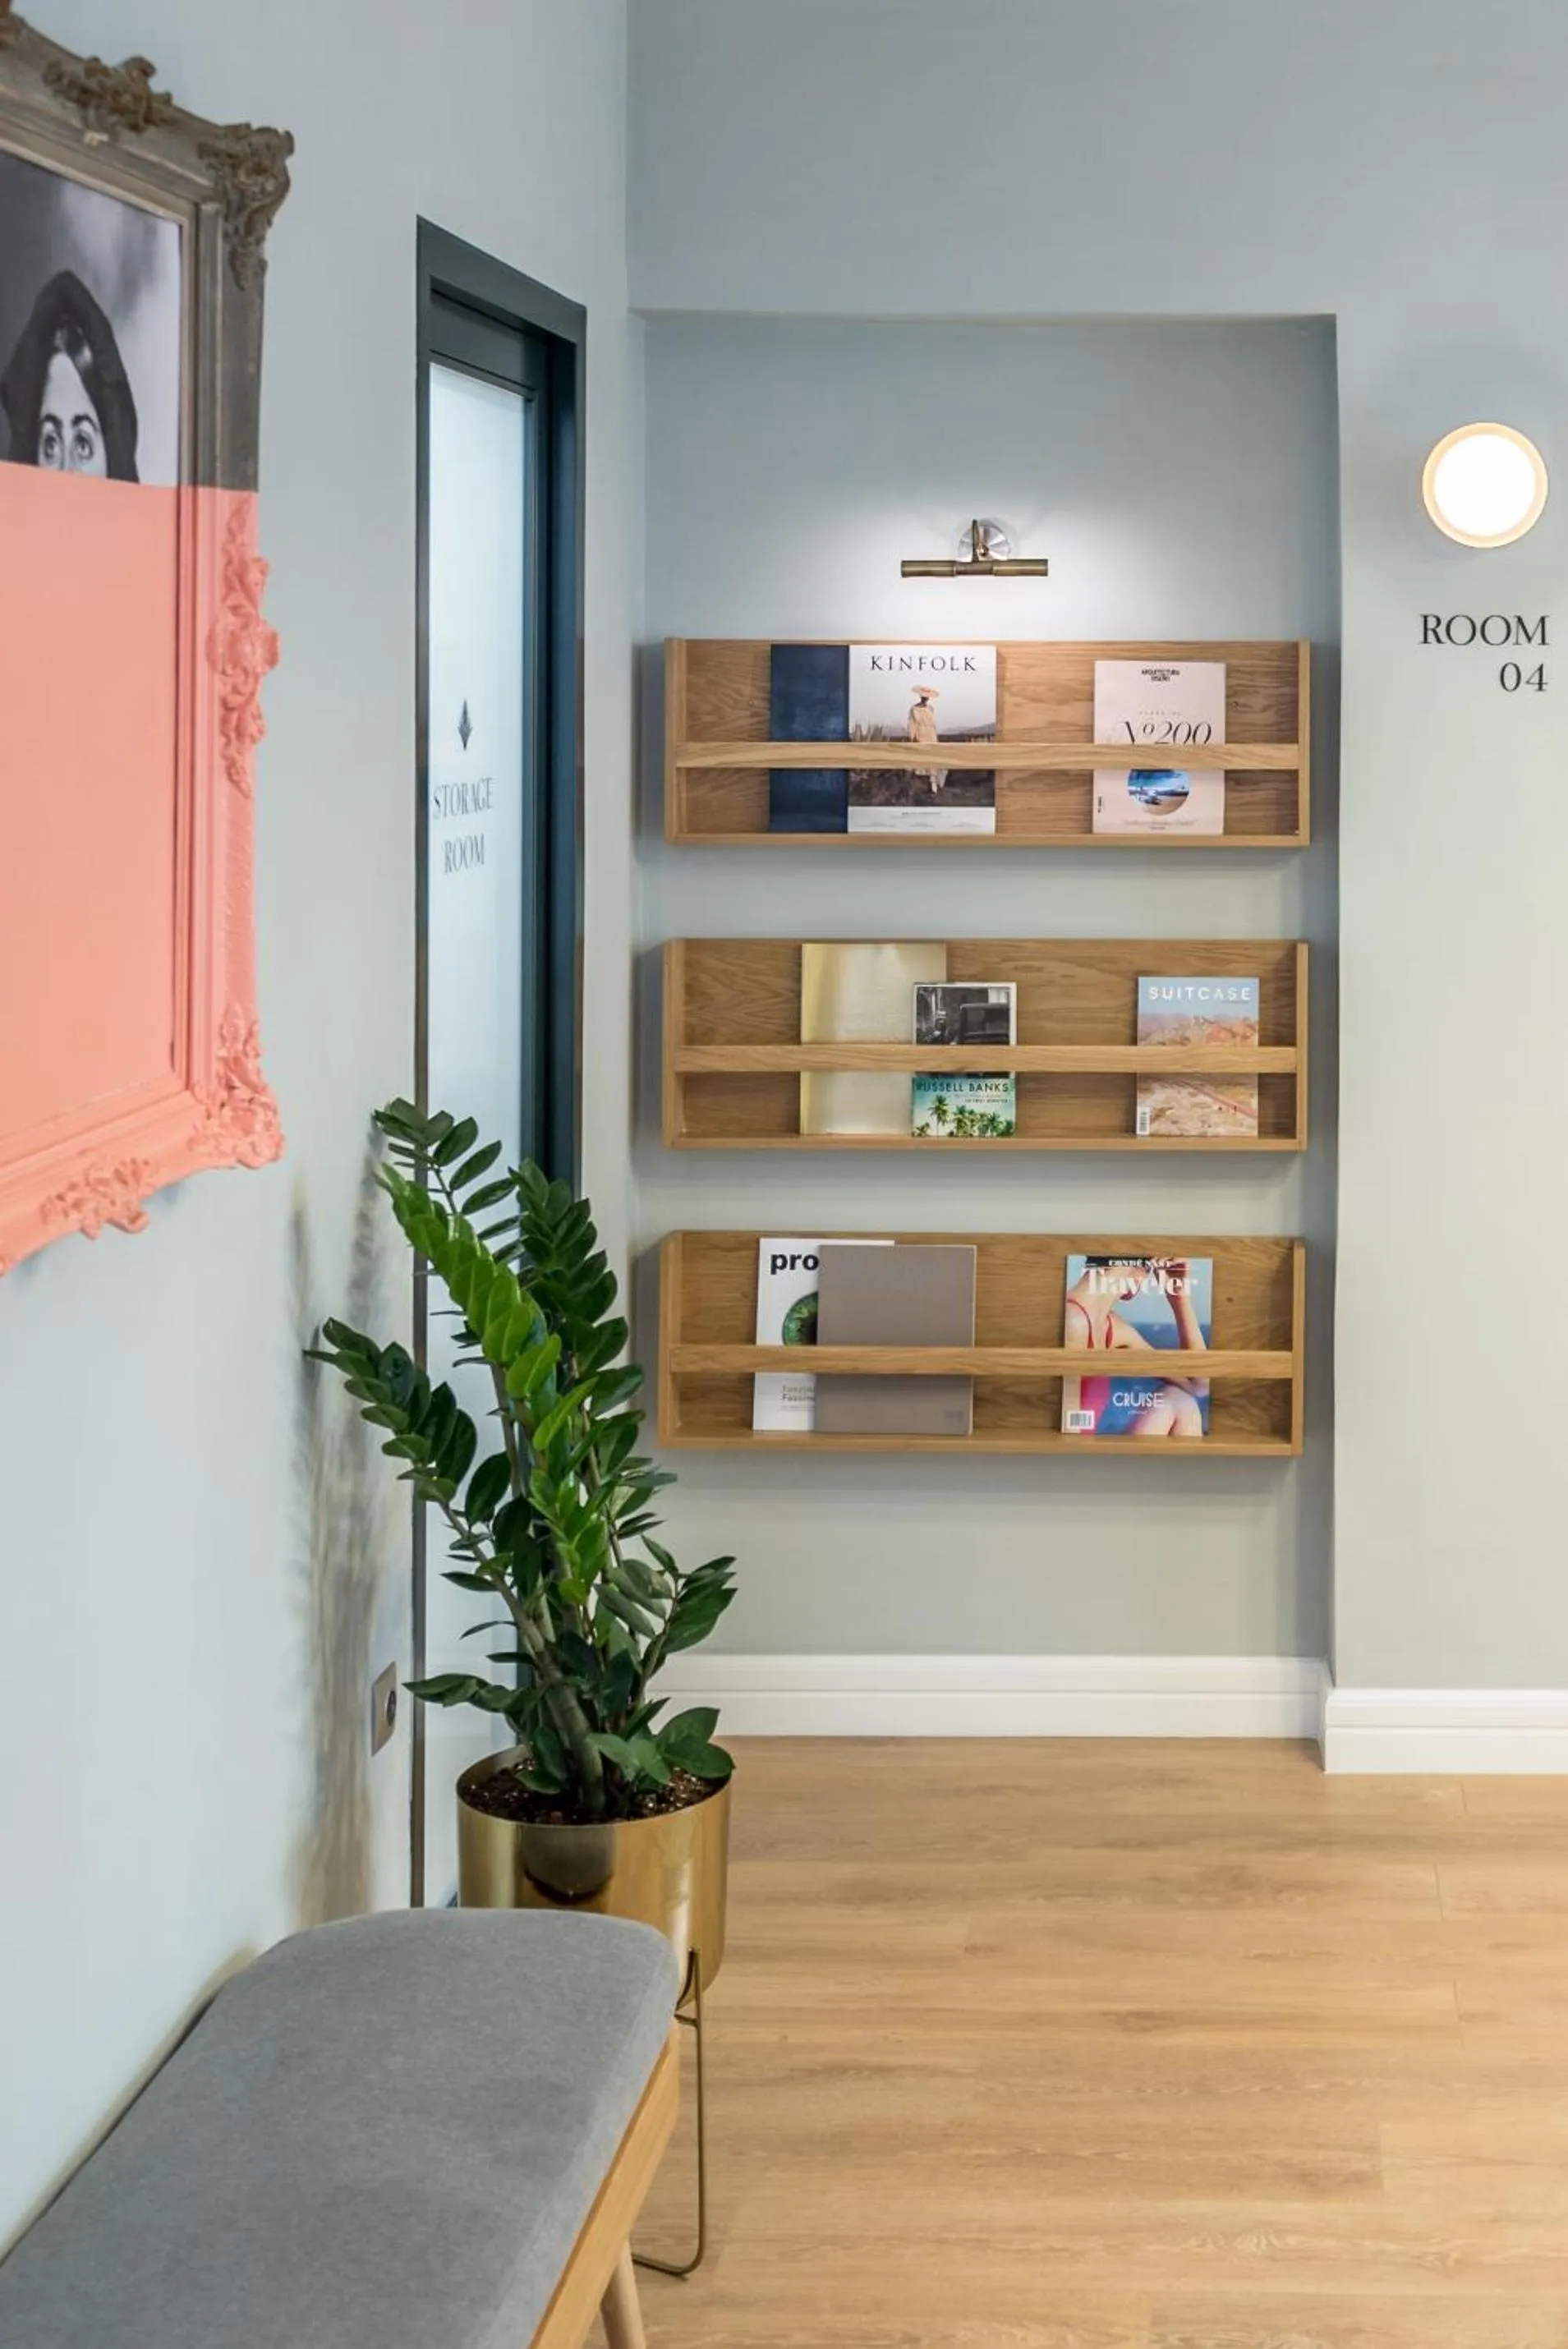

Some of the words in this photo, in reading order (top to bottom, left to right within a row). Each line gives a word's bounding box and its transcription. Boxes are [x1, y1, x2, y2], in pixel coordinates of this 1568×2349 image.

[1419, 614, 1550, 646] ROOM
[871, 655, 977, 671] KINFOLK
[1500, 662, 1548, 692] 04
[434, 778, 494, 820] STORAGE
[444, 833, 485, 874] ROOM
[1148, 987, 1252, 1000] SUITCASE
[916, 1082, 963, 1092] RUSSELL
[969, 1083, 1009, 1092] BANKS
[770, 1253, 819, 1274] pro
[1113, 1391, 1165, 1407] CRUISE
